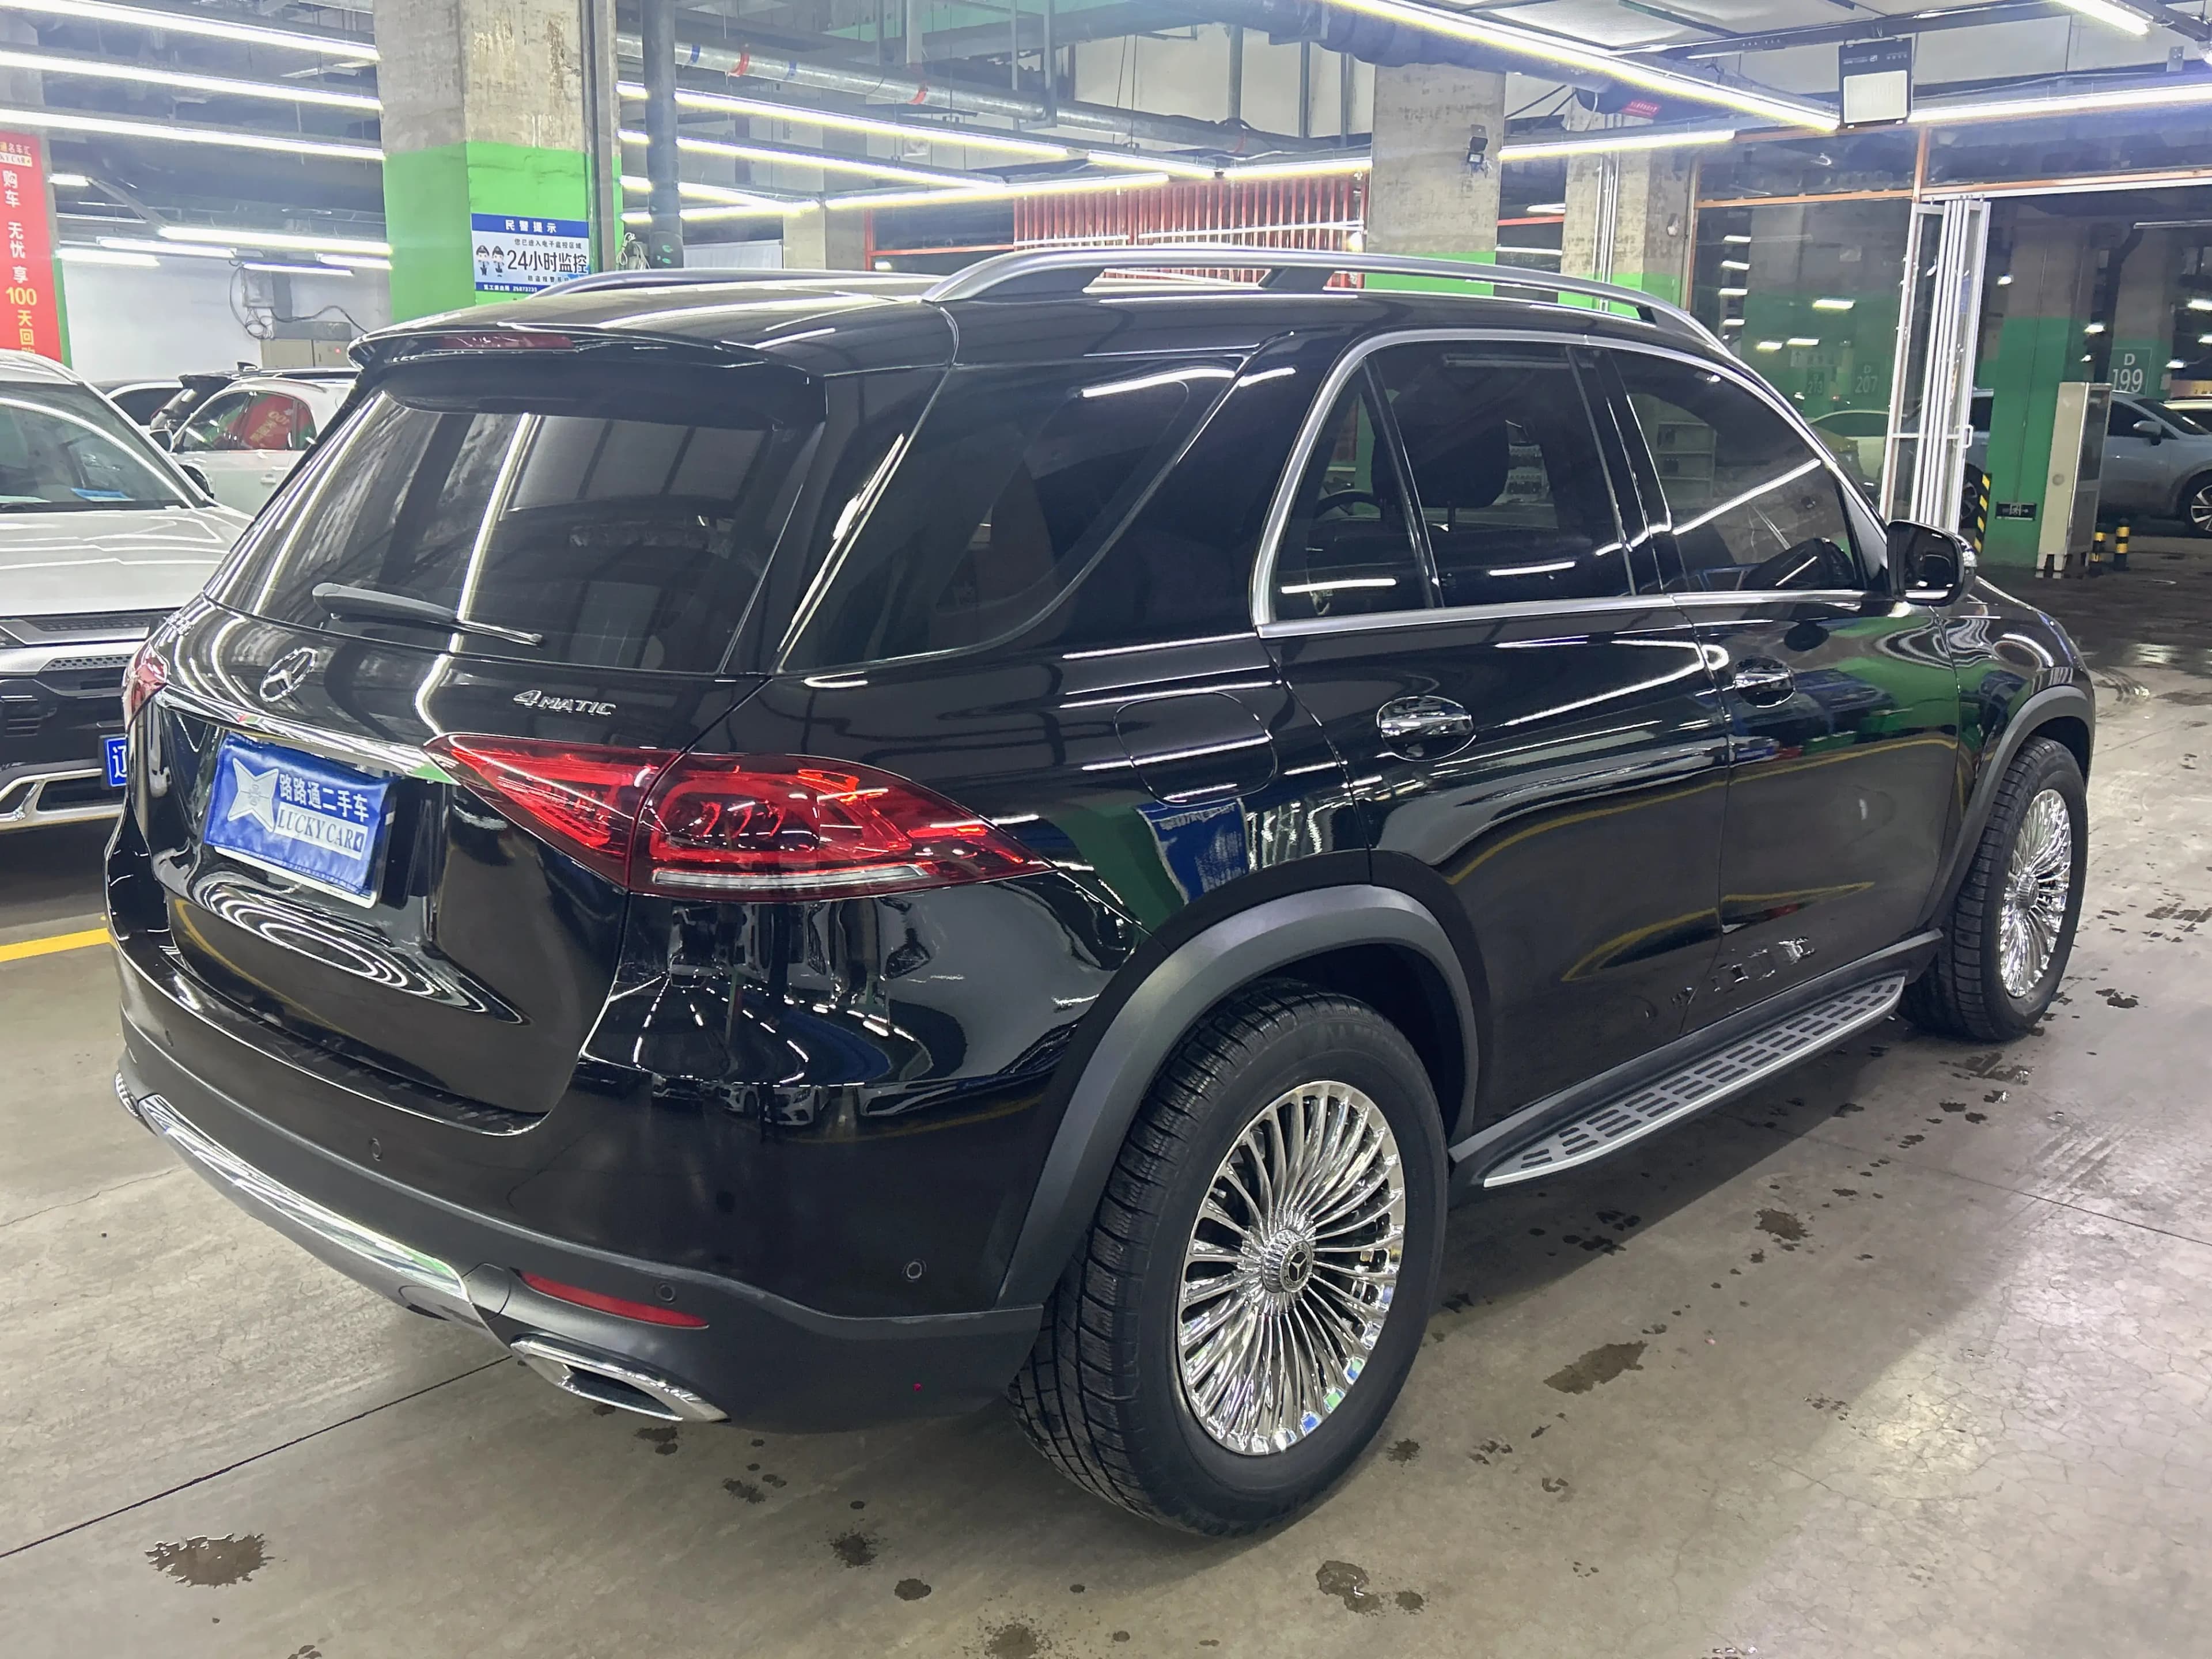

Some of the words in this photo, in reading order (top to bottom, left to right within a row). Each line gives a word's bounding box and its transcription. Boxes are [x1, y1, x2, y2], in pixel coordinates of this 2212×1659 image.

[2, 170, 21, 208] 购车
[505, 219, 556, 233] 民警提示
[7, 221, 25, 259] 无忧
[507, 249, 587, 274] 24小时监控
[12, 265, 28, 284] 享
[5, 286, 37, 306] 100
[17, 309, 35, 353] 天回
[2124, 353, 2135, 366] D
[1855, 375, 1878, 393] 207
[2112, 368, 2143, 393] 199
[513, 690, 616, 715] 4MATIC
[279, 774, 369, 823] 路路通二手车
[277, 809, 326, 837] LUCKY
[326, 824, 353, 850] CAR
